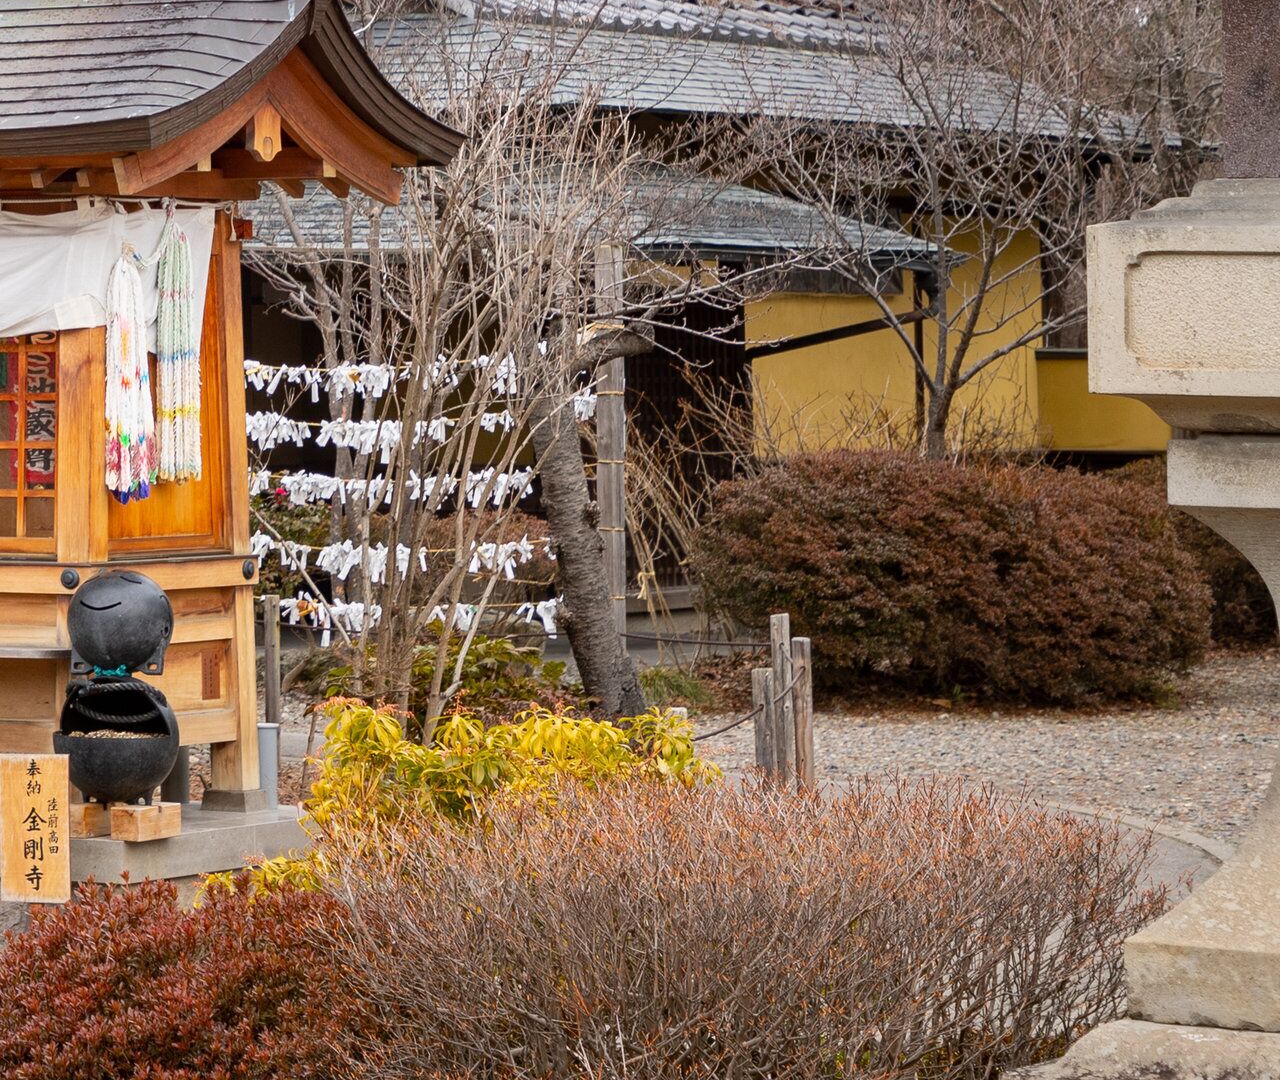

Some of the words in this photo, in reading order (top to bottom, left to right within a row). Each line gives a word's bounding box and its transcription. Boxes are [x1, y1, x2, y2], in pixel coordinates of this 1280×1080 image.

[26, 759, 42, 797] 奉納
[22, 807, 47, 891] 金剛寺
[47, 797, 59, 855] 陸前高田
